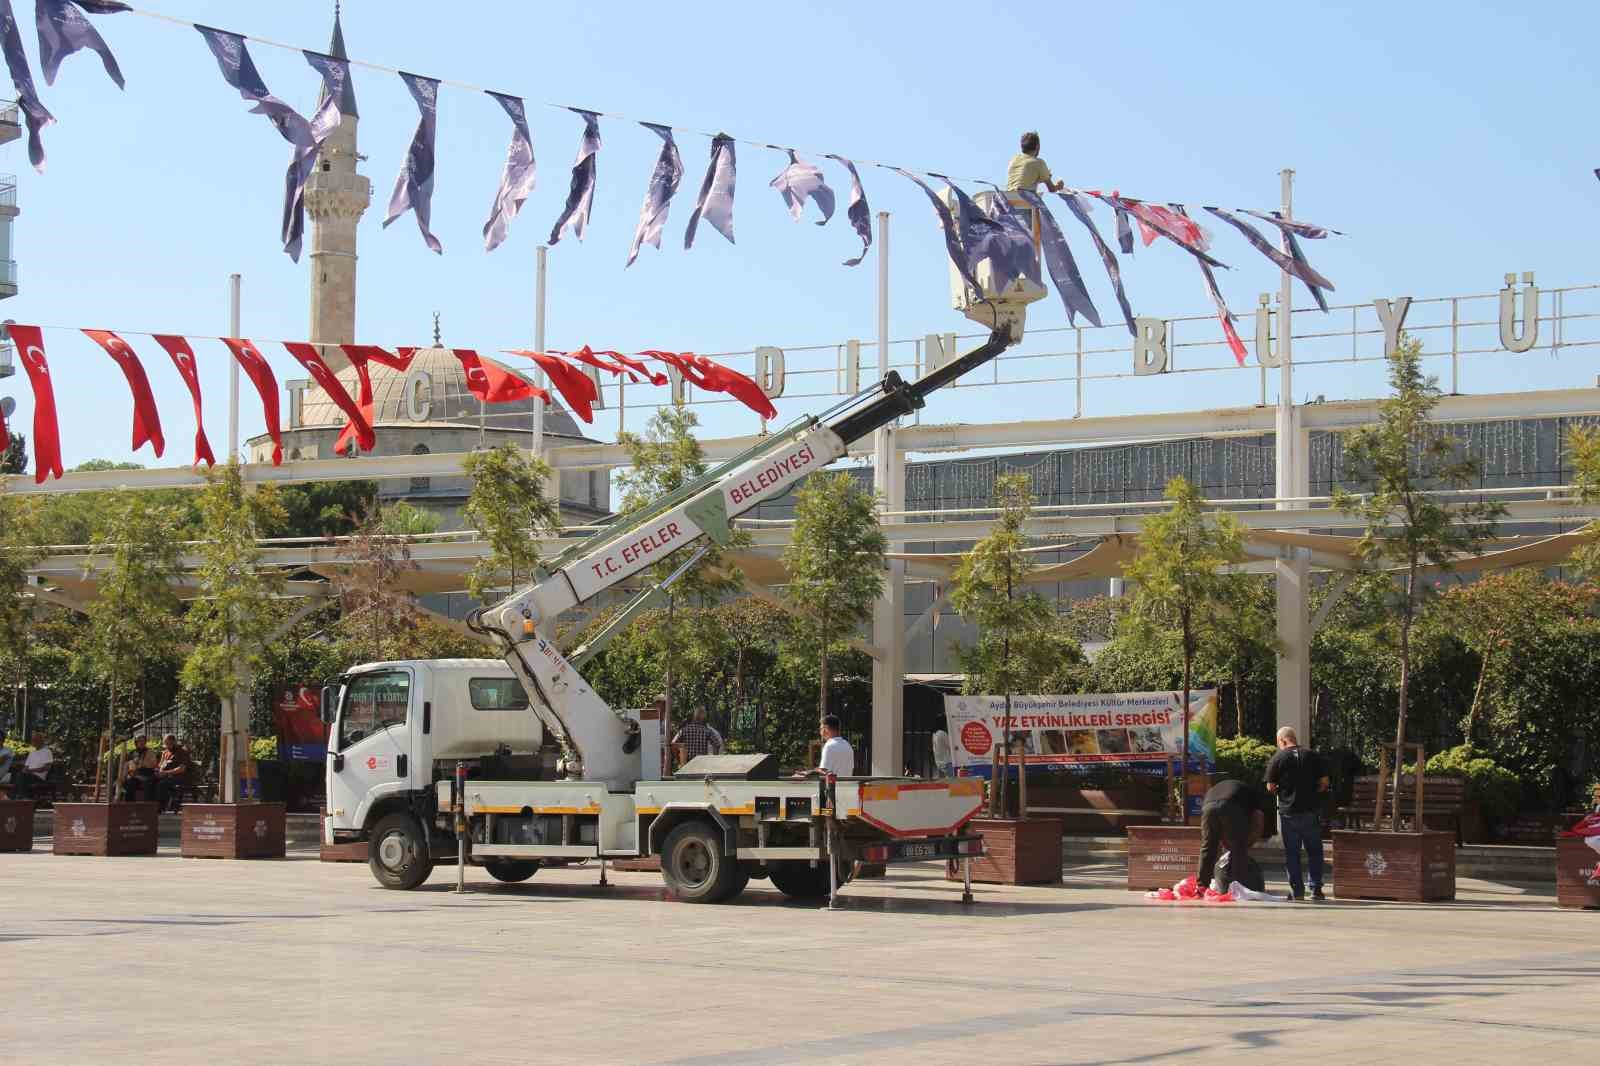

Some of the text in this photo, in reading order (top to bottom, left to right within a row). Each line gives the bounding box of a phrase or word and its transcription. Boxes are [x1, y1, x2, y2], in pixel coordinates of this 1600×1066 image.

[592, 443, 815, 579] T.C. EFELER BELEDİYESİ
[1059, 697, 1099, 708] Belediyesi
[1127, 696, 1169, 706] Merkezleri
[1021, 710, 1112, 729] ETKİNLİKLERİ
[1115, 708, 1170, 726] SERGİSİ
